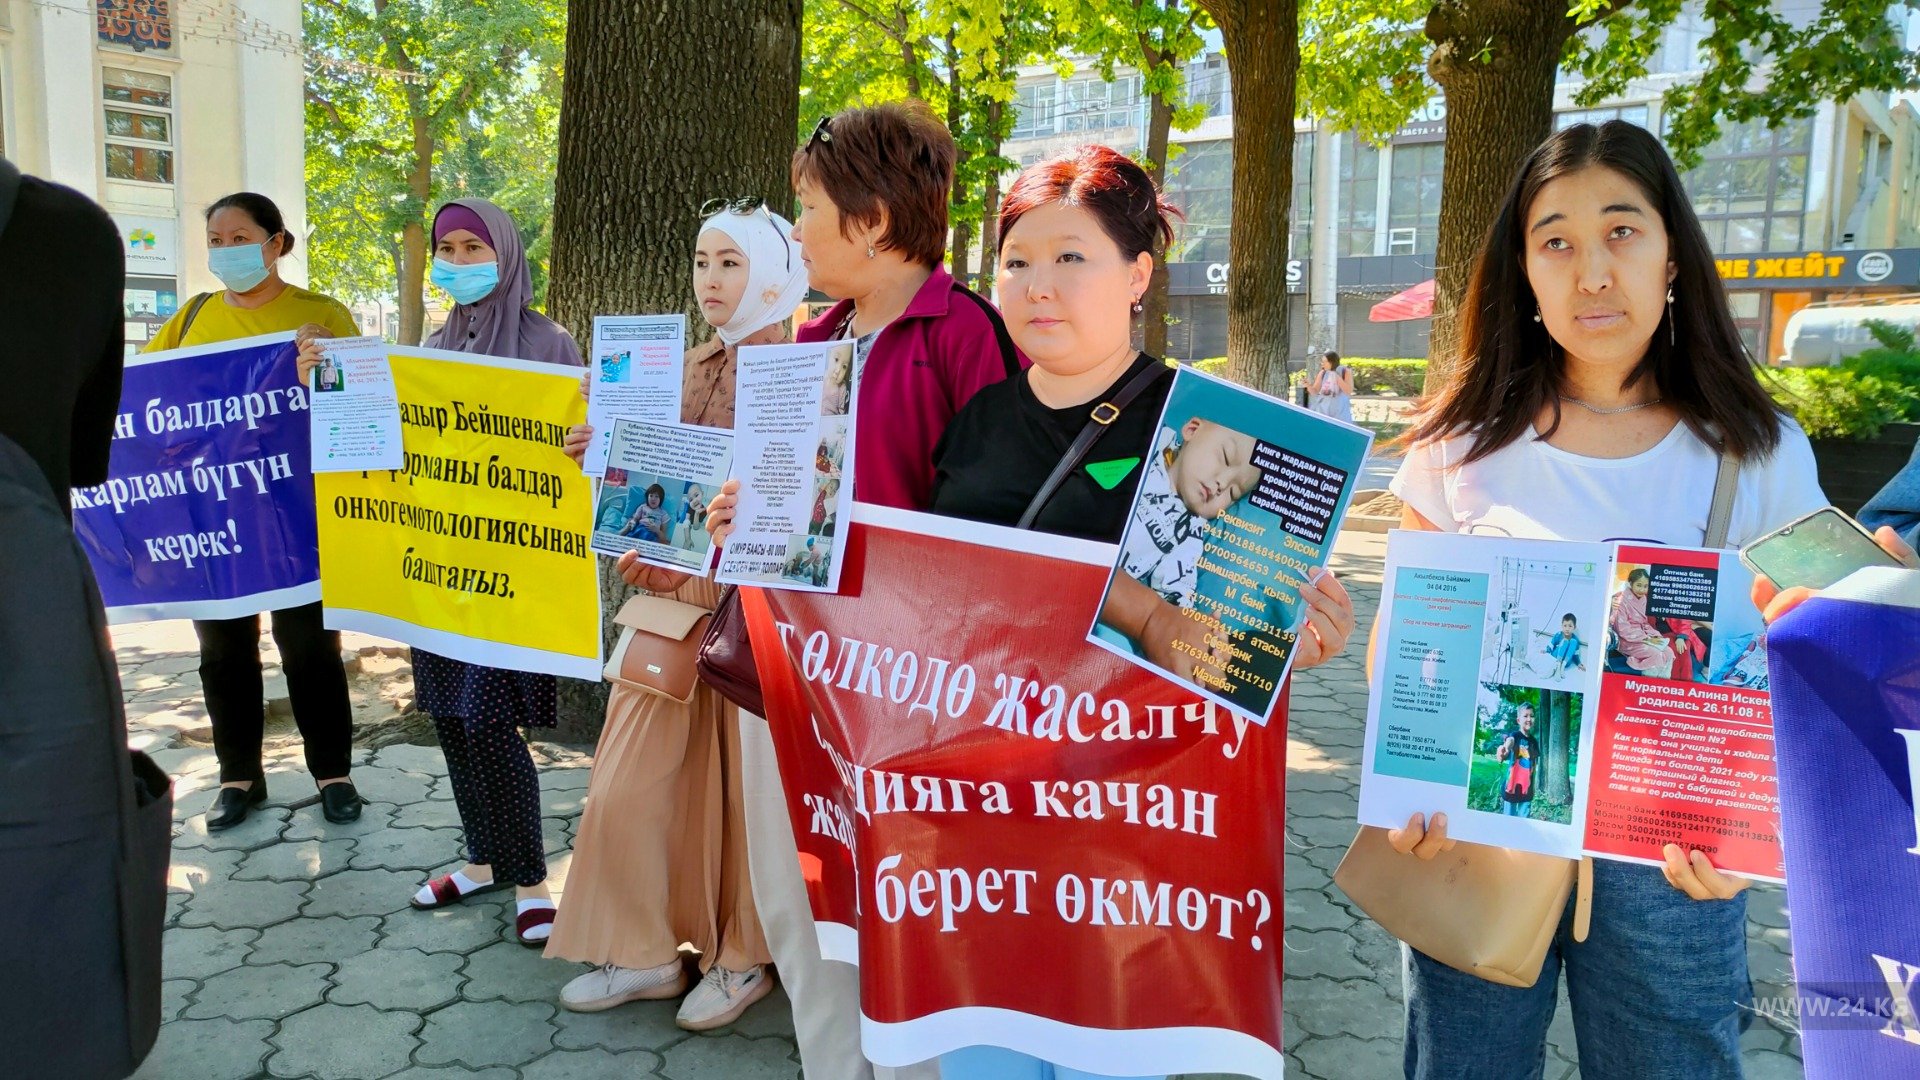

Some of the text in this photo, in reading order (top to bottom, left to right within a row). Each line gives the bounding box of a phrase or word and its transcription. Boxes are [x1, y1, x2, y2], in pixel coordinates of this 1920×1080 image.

[1402, 128, 1428, 136] ПАСТА
[1754, 251, 1846, 278] ЖЕЙТ
[145, 385, 309, 435] балдарга
[400, 401, 448, 438] адыр
[1254, 456, 1339, 494] Аккан оорусуна (рак
[1256, 443, 1344, 482] Алиге жардам керек
[69, 453, 294, 514] жардам бүгүн
[487, 455, 563, 509] балдар
[1263, 474, 1335, 506] крови)чалдыгып
[1251, 495, 1324, 529] карабаныздарчы
[1259, 485, 1331, 518] калды.Кайдыгер
[334, 494, 588, 559] онкогемотологиясынан
[1216, 508, 1320, 558] Реквизит Элсом
[1285, 522, 1322, 541] сураныч
[144, 519, 243, 569] керек!
[402, 547, 515, 599] баштаңыз.
[1196, 557, 1296, 605] Шамшарбек кызы
[1204, 542, 1300, 589] 0700964653 Апас
[1224, 586, 1267, 613] М банк
[1182, 607, 1286, 659] 0709224146 атасы.
[1203, 633, 1253, 664] Сбербанк
[801, 628, 978, 720] өлкөдө
[983, 672, 1251, 760] жасалчу
[1192, 665, 1238, 694] Махабат
[1624, 680, 1771, 707] Муратова Алина Искен
[1614, 712, 1660, 728] Диагноз:
[1662, 719, 1705, 732] Острый
[1638, 696, 1700, 711] родилась
[1702, 703, 1753, 718] 26.11.08
[1613, 732, 1637, 744] Как
[1641, 738, 1659, 746] все
[1660, 740, 1678, 749] она
[1680, 743, 1722, 755] училась
[1732, 749, 1770, 761] ходила
[1660, 729, 1727, 745] Вариант №2
[1611, 752, 1652, 766] Никогда
[1710, 766, 1732, 776] 2021
[1734, 770, 1758, 781] году
[1761, 773, 1779, 784] узн
[1612, 743, 1724, 765] как нормальные дети
[1609, 773, 1641, 784] Алина
[1642, 778, 1676, 789] живет
[1686, 783, 1737, 798] бабушкой
[1748, 791, 1780, 804] дедуш
[1610, 763, 1742, 788] этот страшный диагноз.
[1030, 779, 1219, 840] качан
[1608, 782, 1628, 792] так
[1630, 785, 1647, 794] как
[1649, 789, 1660, 797] ее
[1661, 790, 1713, 805] родители
[1715, 798, 1769, 813] развелись
[1634, 806, 1657, 816] банк
[874, 853, 1037, 933] берет
[1054, 872, 1273, 952] өкмөт?
